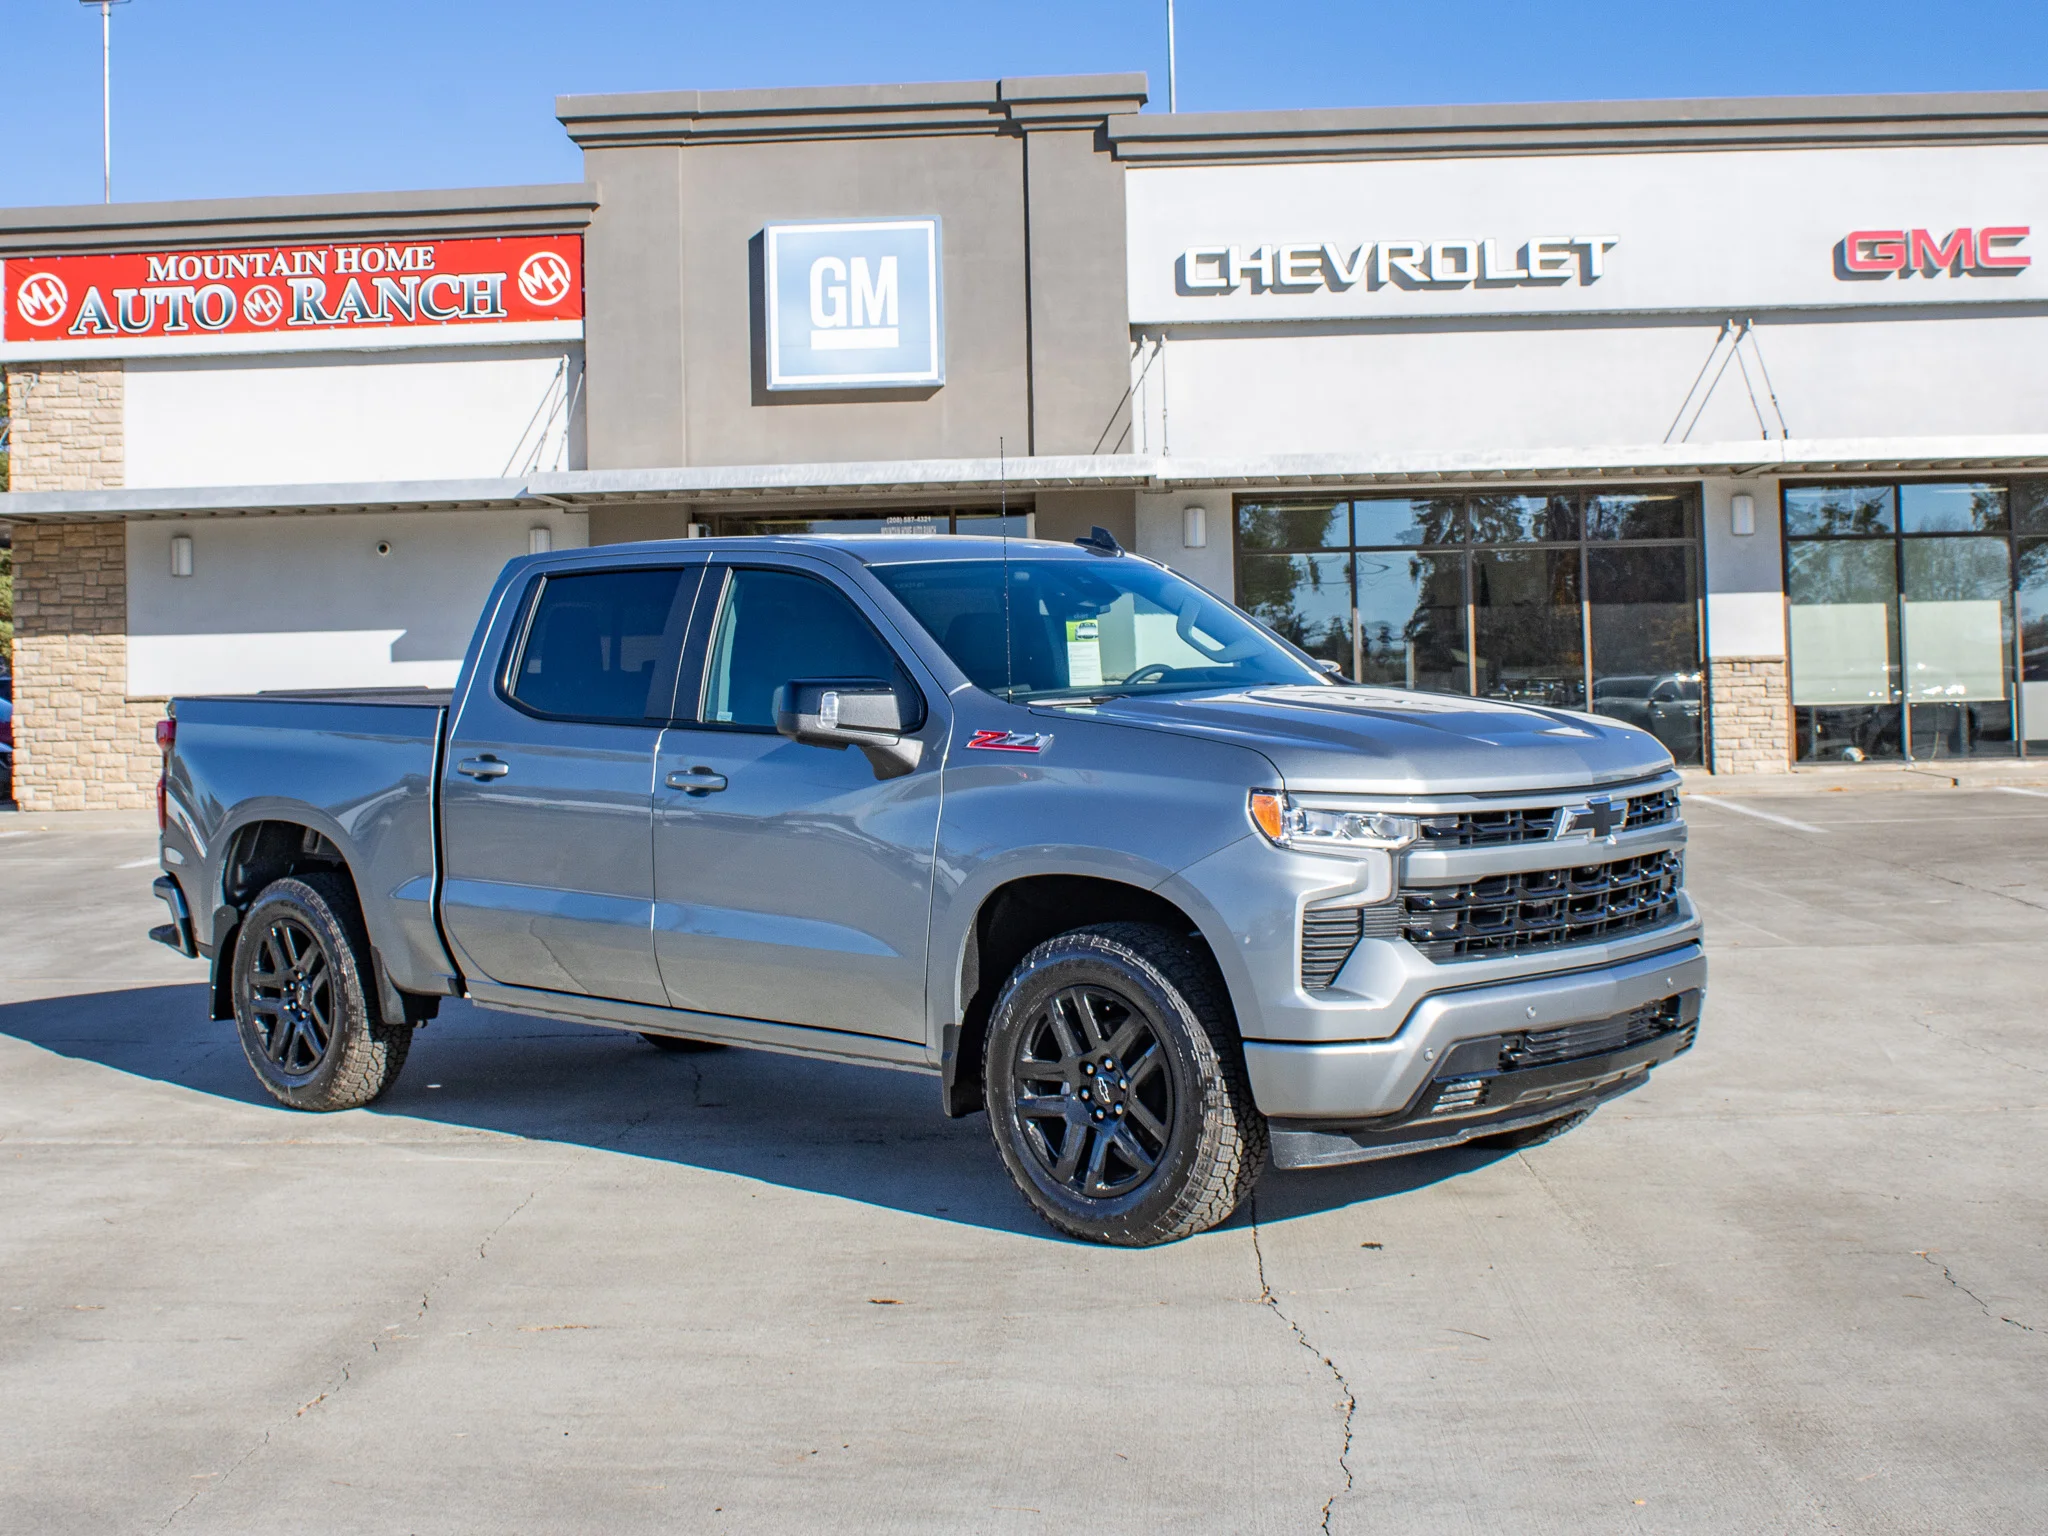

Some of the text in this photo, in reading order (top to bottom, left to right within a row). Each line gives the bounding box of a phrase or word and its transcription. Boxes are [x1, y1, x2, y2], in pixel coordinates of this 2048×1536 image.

[146, 245, 436, 282] MOUNTAIN HOME
[1183, 234, 1620, 289] CHEVROLET
[1846, 225, 2032, 272] GMC
[67, 272, 508, 335] AUTO RANCH
[809, 255, 899, 329] GM
